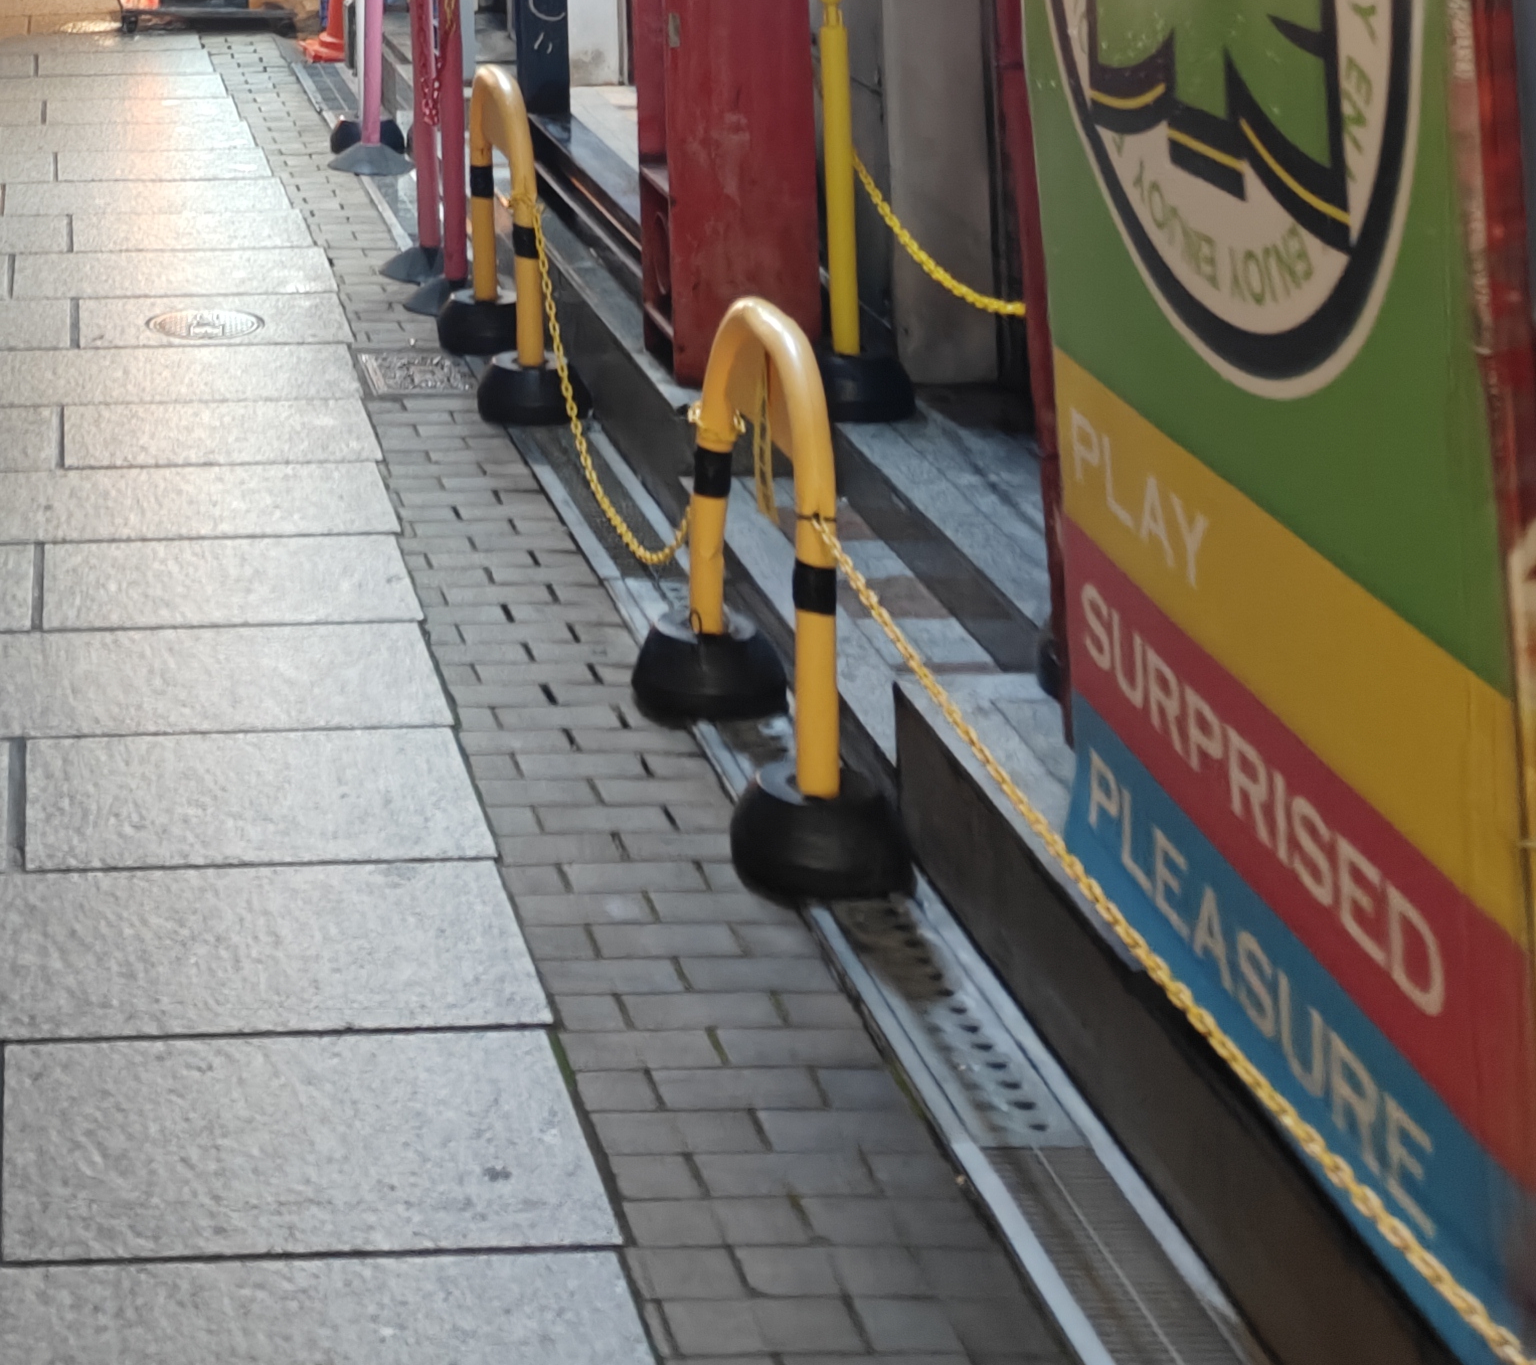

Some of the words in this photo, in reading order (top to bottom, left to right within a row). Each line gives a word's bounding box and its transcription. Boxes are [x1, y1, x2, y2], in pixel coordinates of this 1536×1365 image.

[1070, 408, 1209, 589] PLAY
[1079, 582, 1446, 1017] SURPRISED
[1087, 746, 1436, 1239] PLEASURE
